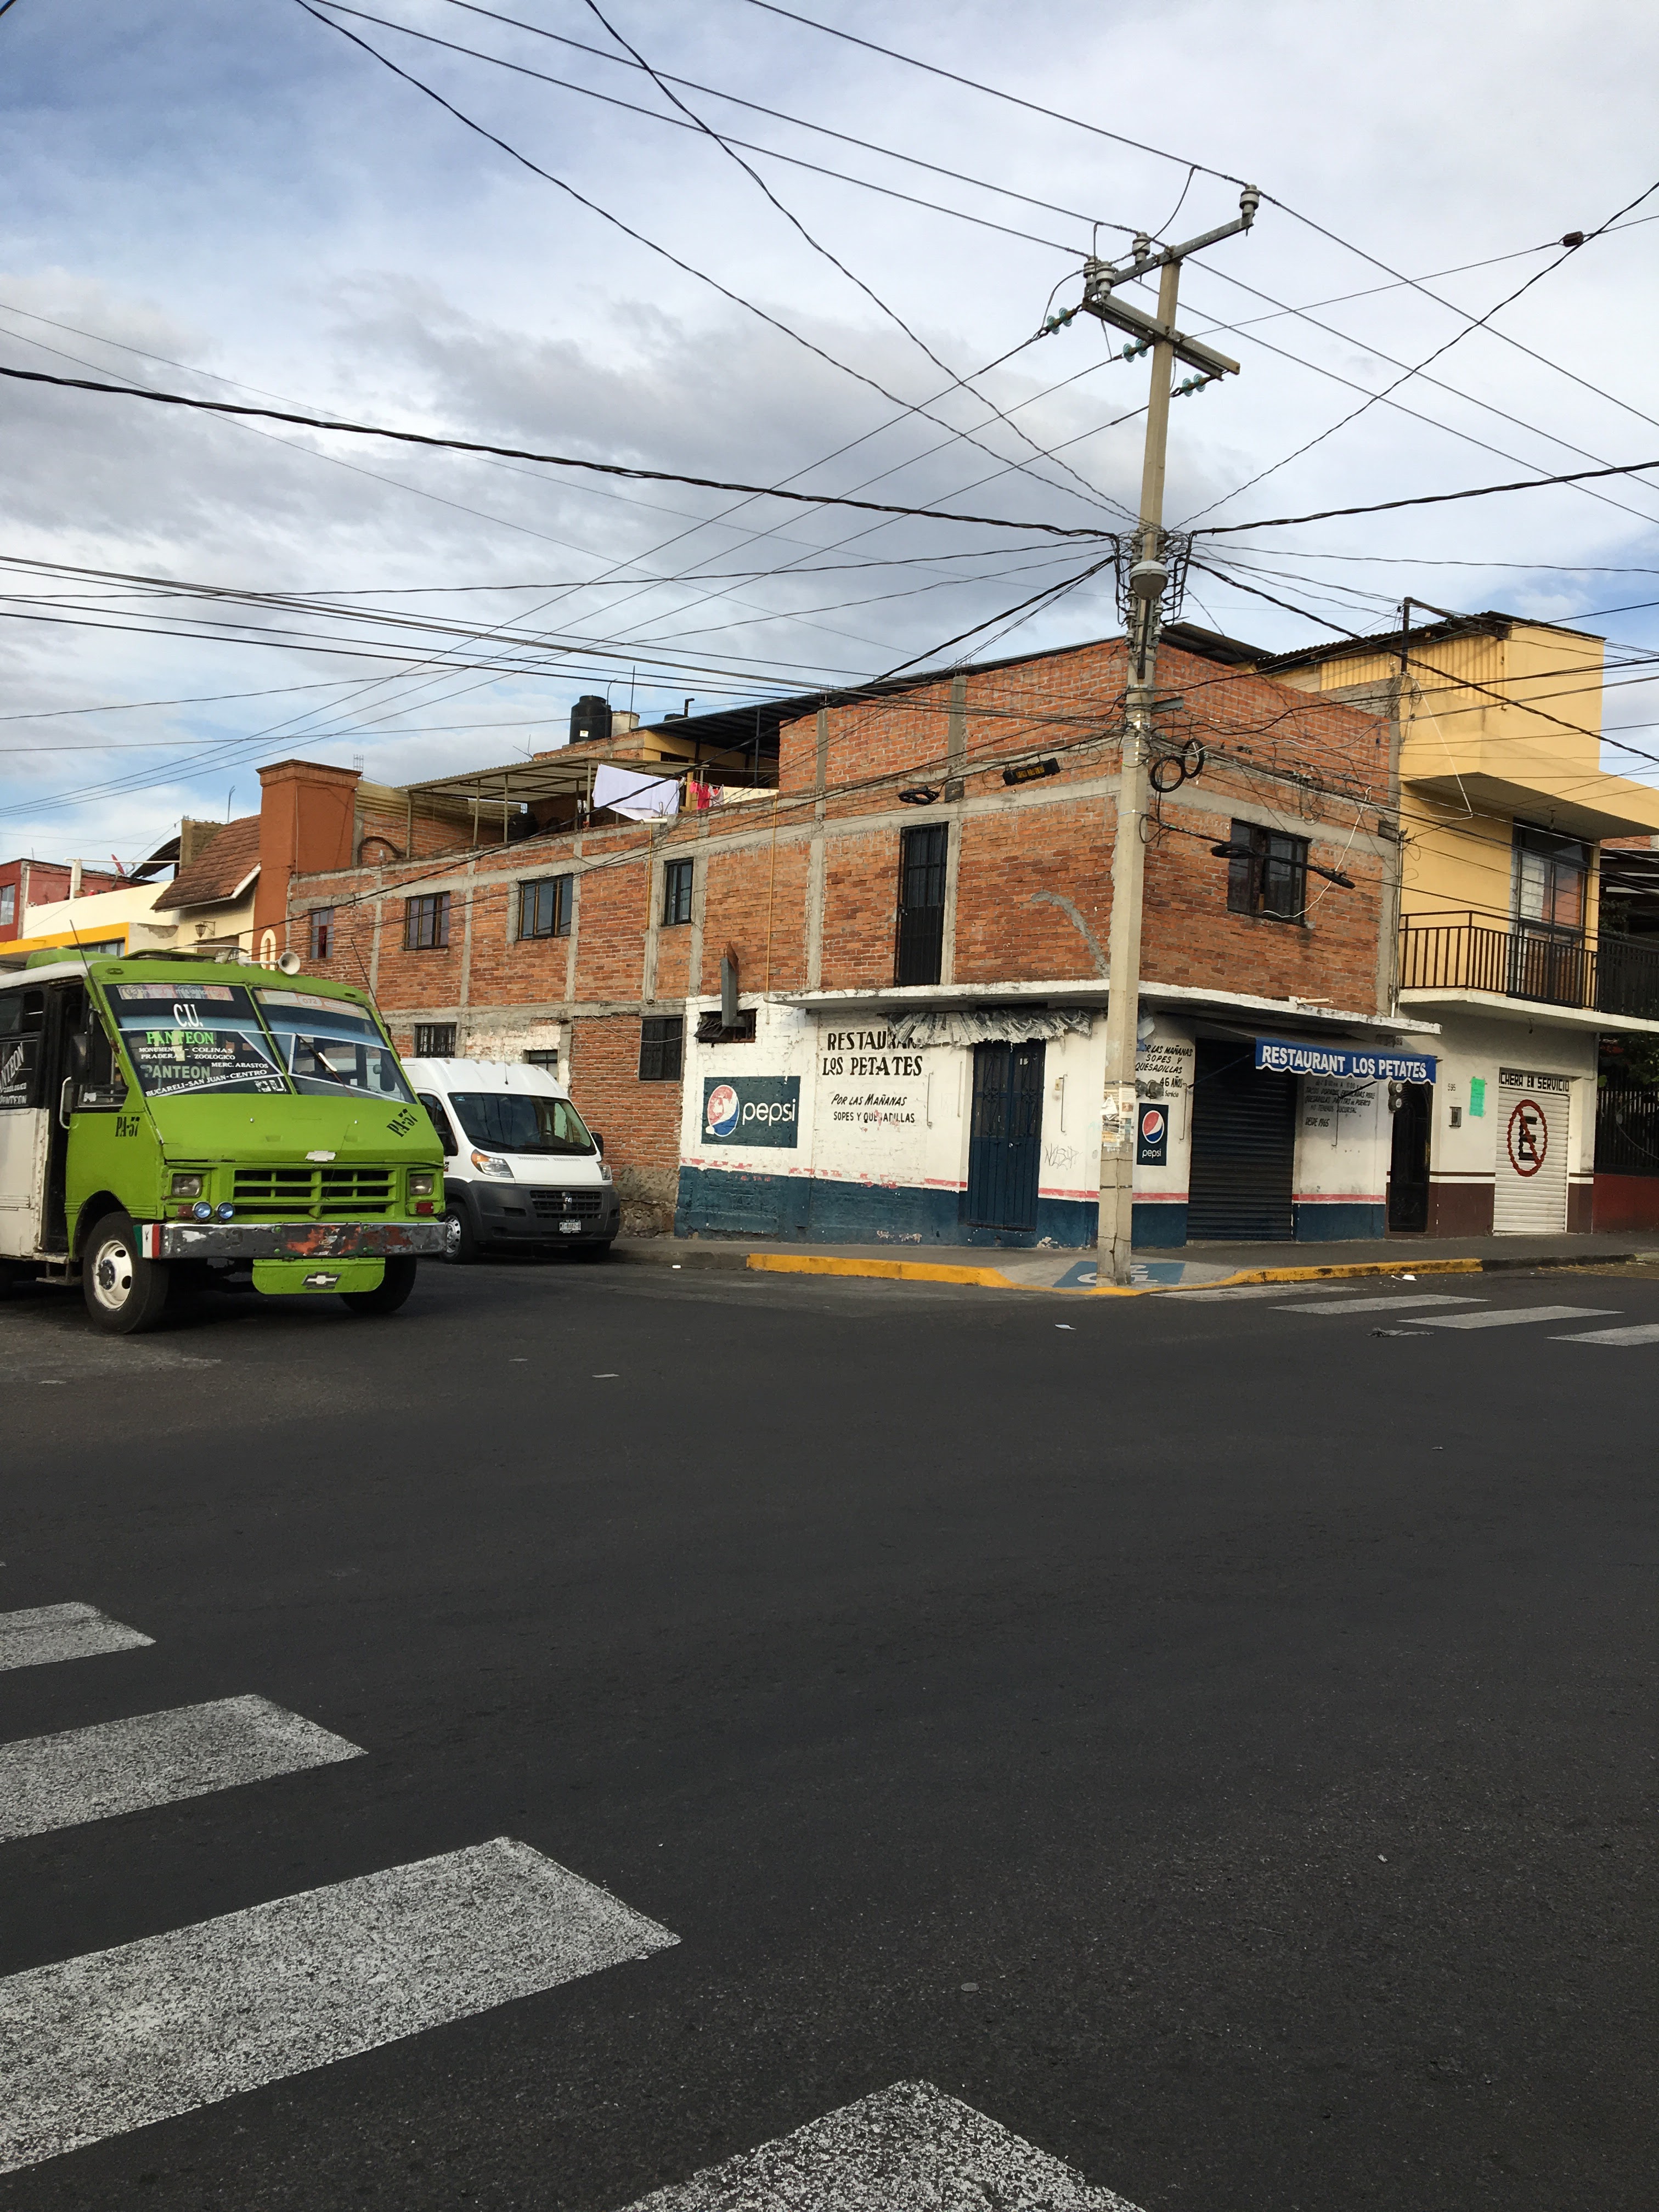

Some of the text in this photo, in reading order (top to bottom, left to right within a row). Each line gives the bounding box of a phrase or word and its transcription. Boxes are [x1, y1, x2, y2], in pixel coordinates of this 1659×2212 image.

[173, 1004, 204, 1028] C.U.
[146, 1031, 215, 1045] PANTEON
[1151, 1045, 1163, 1054] LAS
[1164, 1045, 1193, 1057] MAÑANAS
[822, 1056, 923, 1076] LOS PETATES
[1146, 1054, 1172, 1064] SOPES
[1262, 1045, 1427, 1078] RESTAURANT LOS PETATES
[1135, 1062, 1183, 1074] QUESADILLAS
[1159, 1077, 1170, 1086] 46
[1527, 1075, 1534, 1088] EN
[1537, 1076, 1569, 1092] SERVICIO
[831, 1093, 907, 1106] POR LAS MAÑANAS
[742, 1098, 796, 1126] pepsi
[833, 1111, 854, 1121] SOPES
[856, 1111, 862, 1121] Y
[115, 1116, 140, 1137] PA-57
[386, 1108, 419, 1137] PA-57
[1142, 1148, 1162, 1159] pepsi
